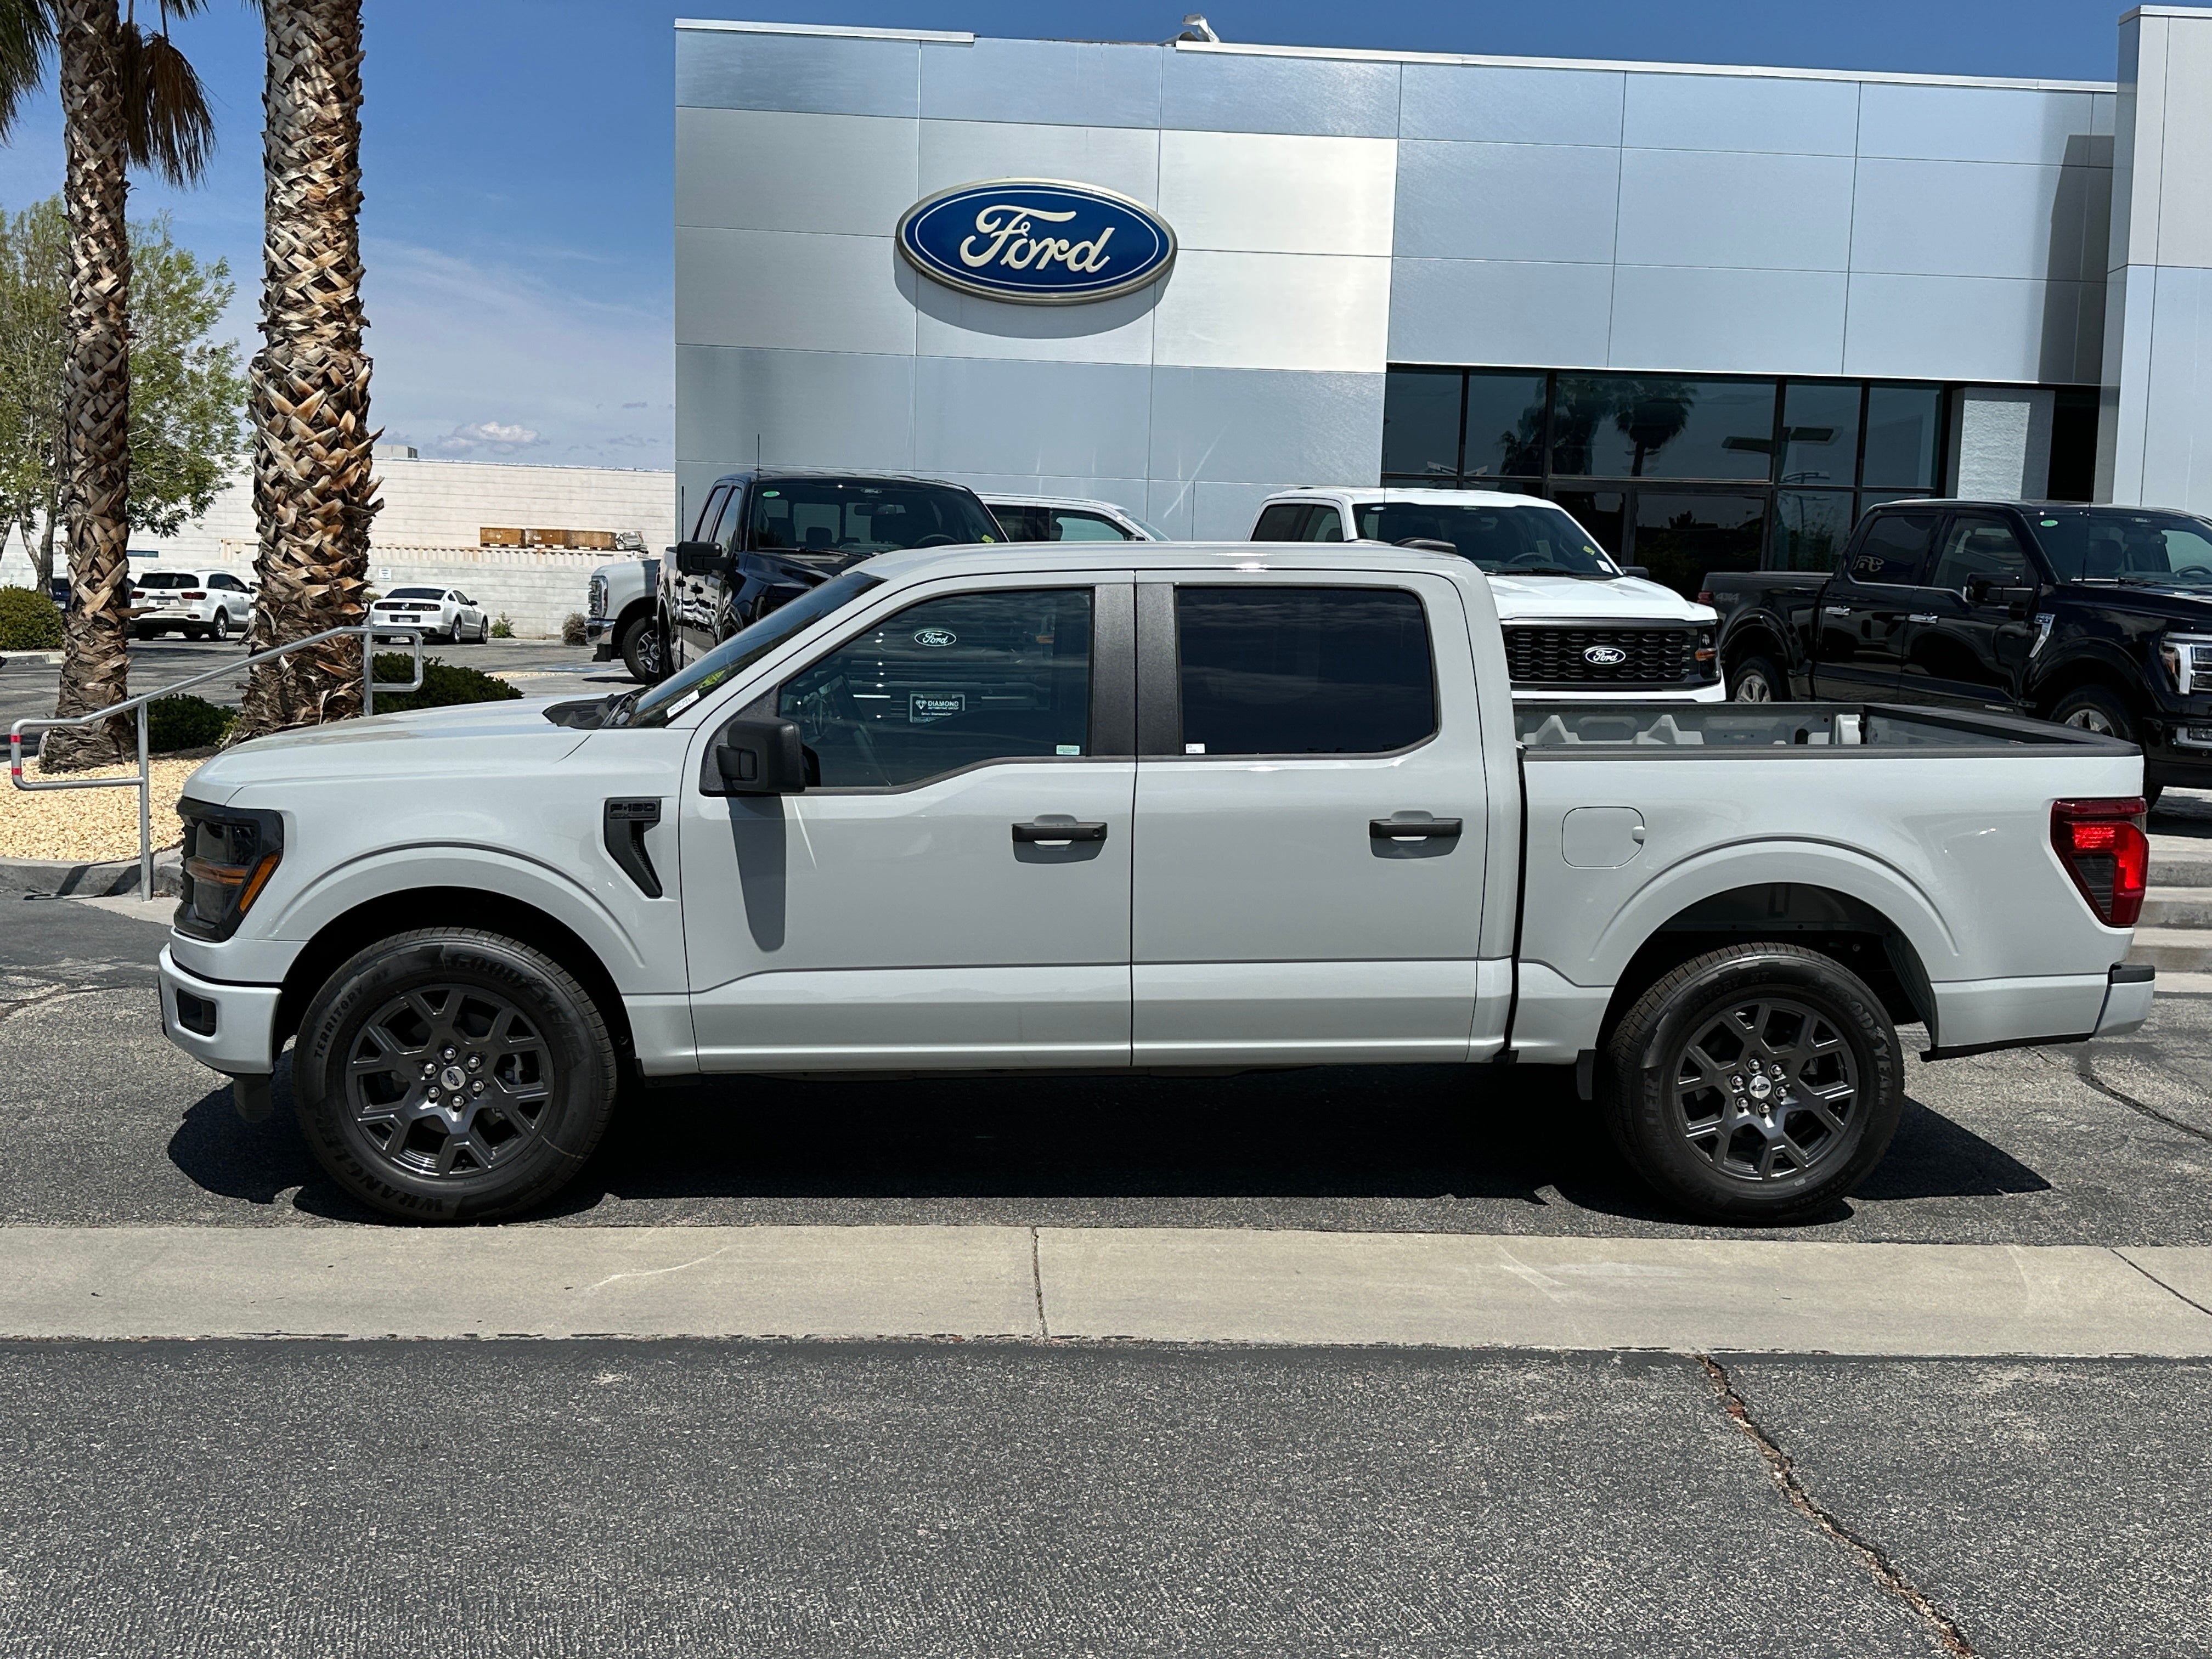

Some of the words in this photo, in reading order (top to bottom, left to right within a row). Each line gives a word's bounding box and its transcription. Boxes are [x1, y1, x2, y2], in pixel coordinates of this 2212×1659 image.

[960, 205, 1115, 273] Ford
[922, 632, 949, 644] Ford
[1593, 650, 1618, 662] Ford
[610, 803, 656, 812] F-150
[314, 984, 363, 1059] TERRITORY
